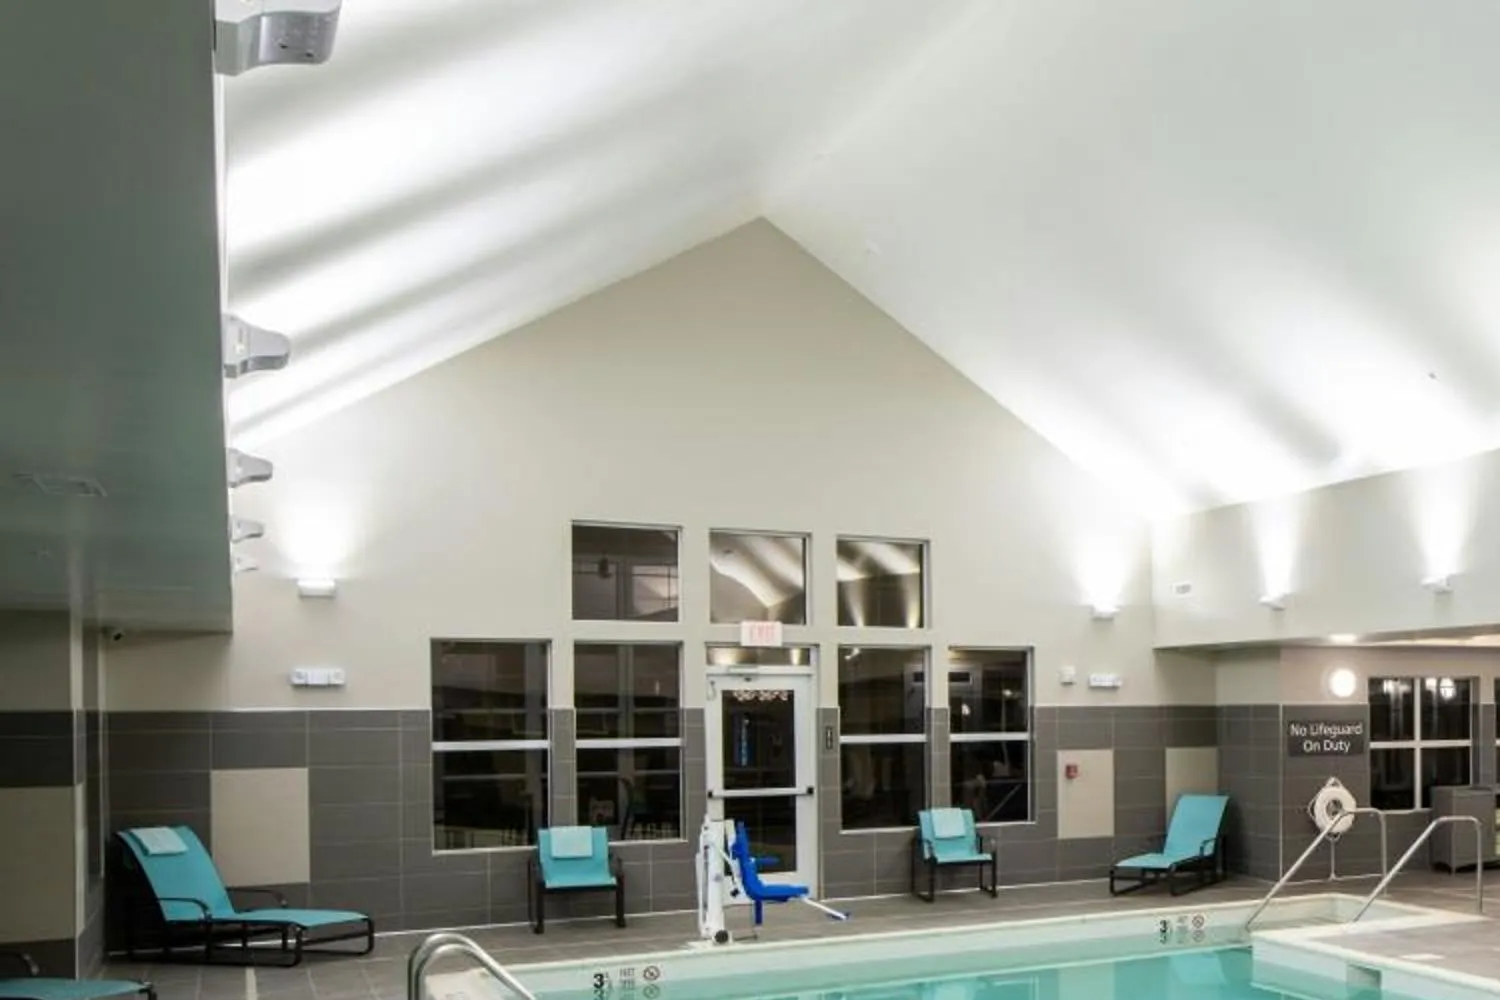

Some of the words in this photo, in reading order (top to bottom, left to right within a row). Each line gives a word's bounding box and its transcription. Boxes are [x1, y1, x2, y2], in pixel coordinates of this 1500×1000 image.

[1290, 723, 1307, 737] No
[1310, 722, 1363, 739] Lifeguard
[1303, 739, 1321, 753] On
[1323, 739, 1351, 755] Duty
